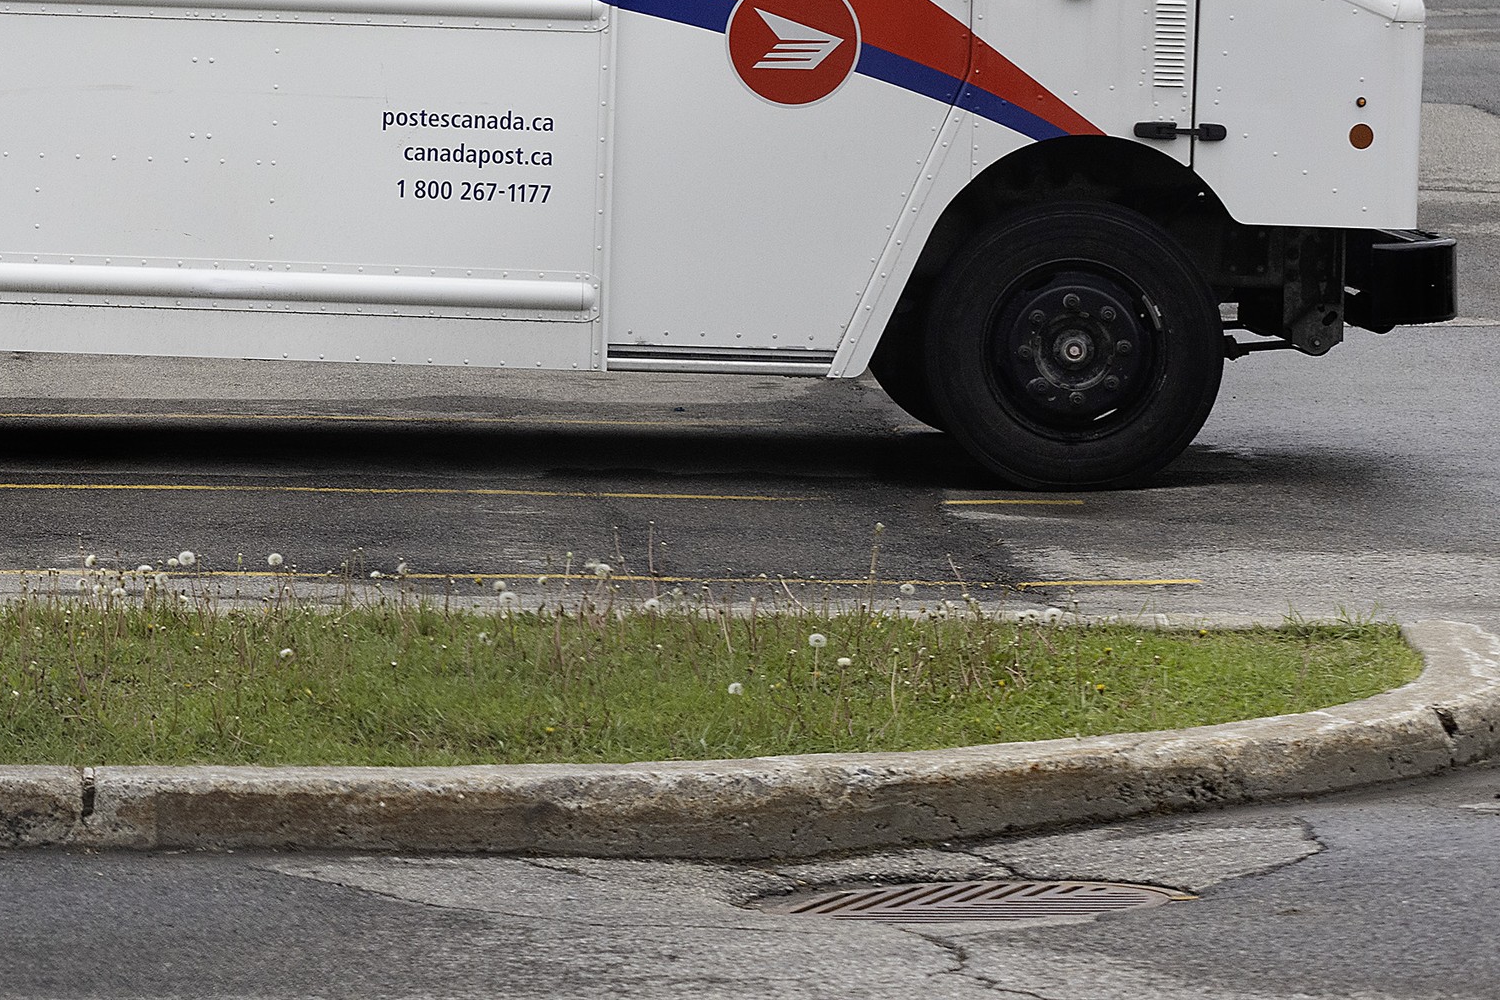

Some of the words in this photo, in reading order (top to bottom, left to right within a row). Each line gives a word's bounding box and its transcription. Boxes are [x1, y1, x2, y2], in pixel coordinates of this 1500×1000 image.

[382, 109, 554, 131] postescanada.ca
[403, 142, 553, 168] canadapost.ca
[396, 179, 405, 198] 1
[414, 180, 453, 200] 800
[460, 181, 552, 204] 267-1177
